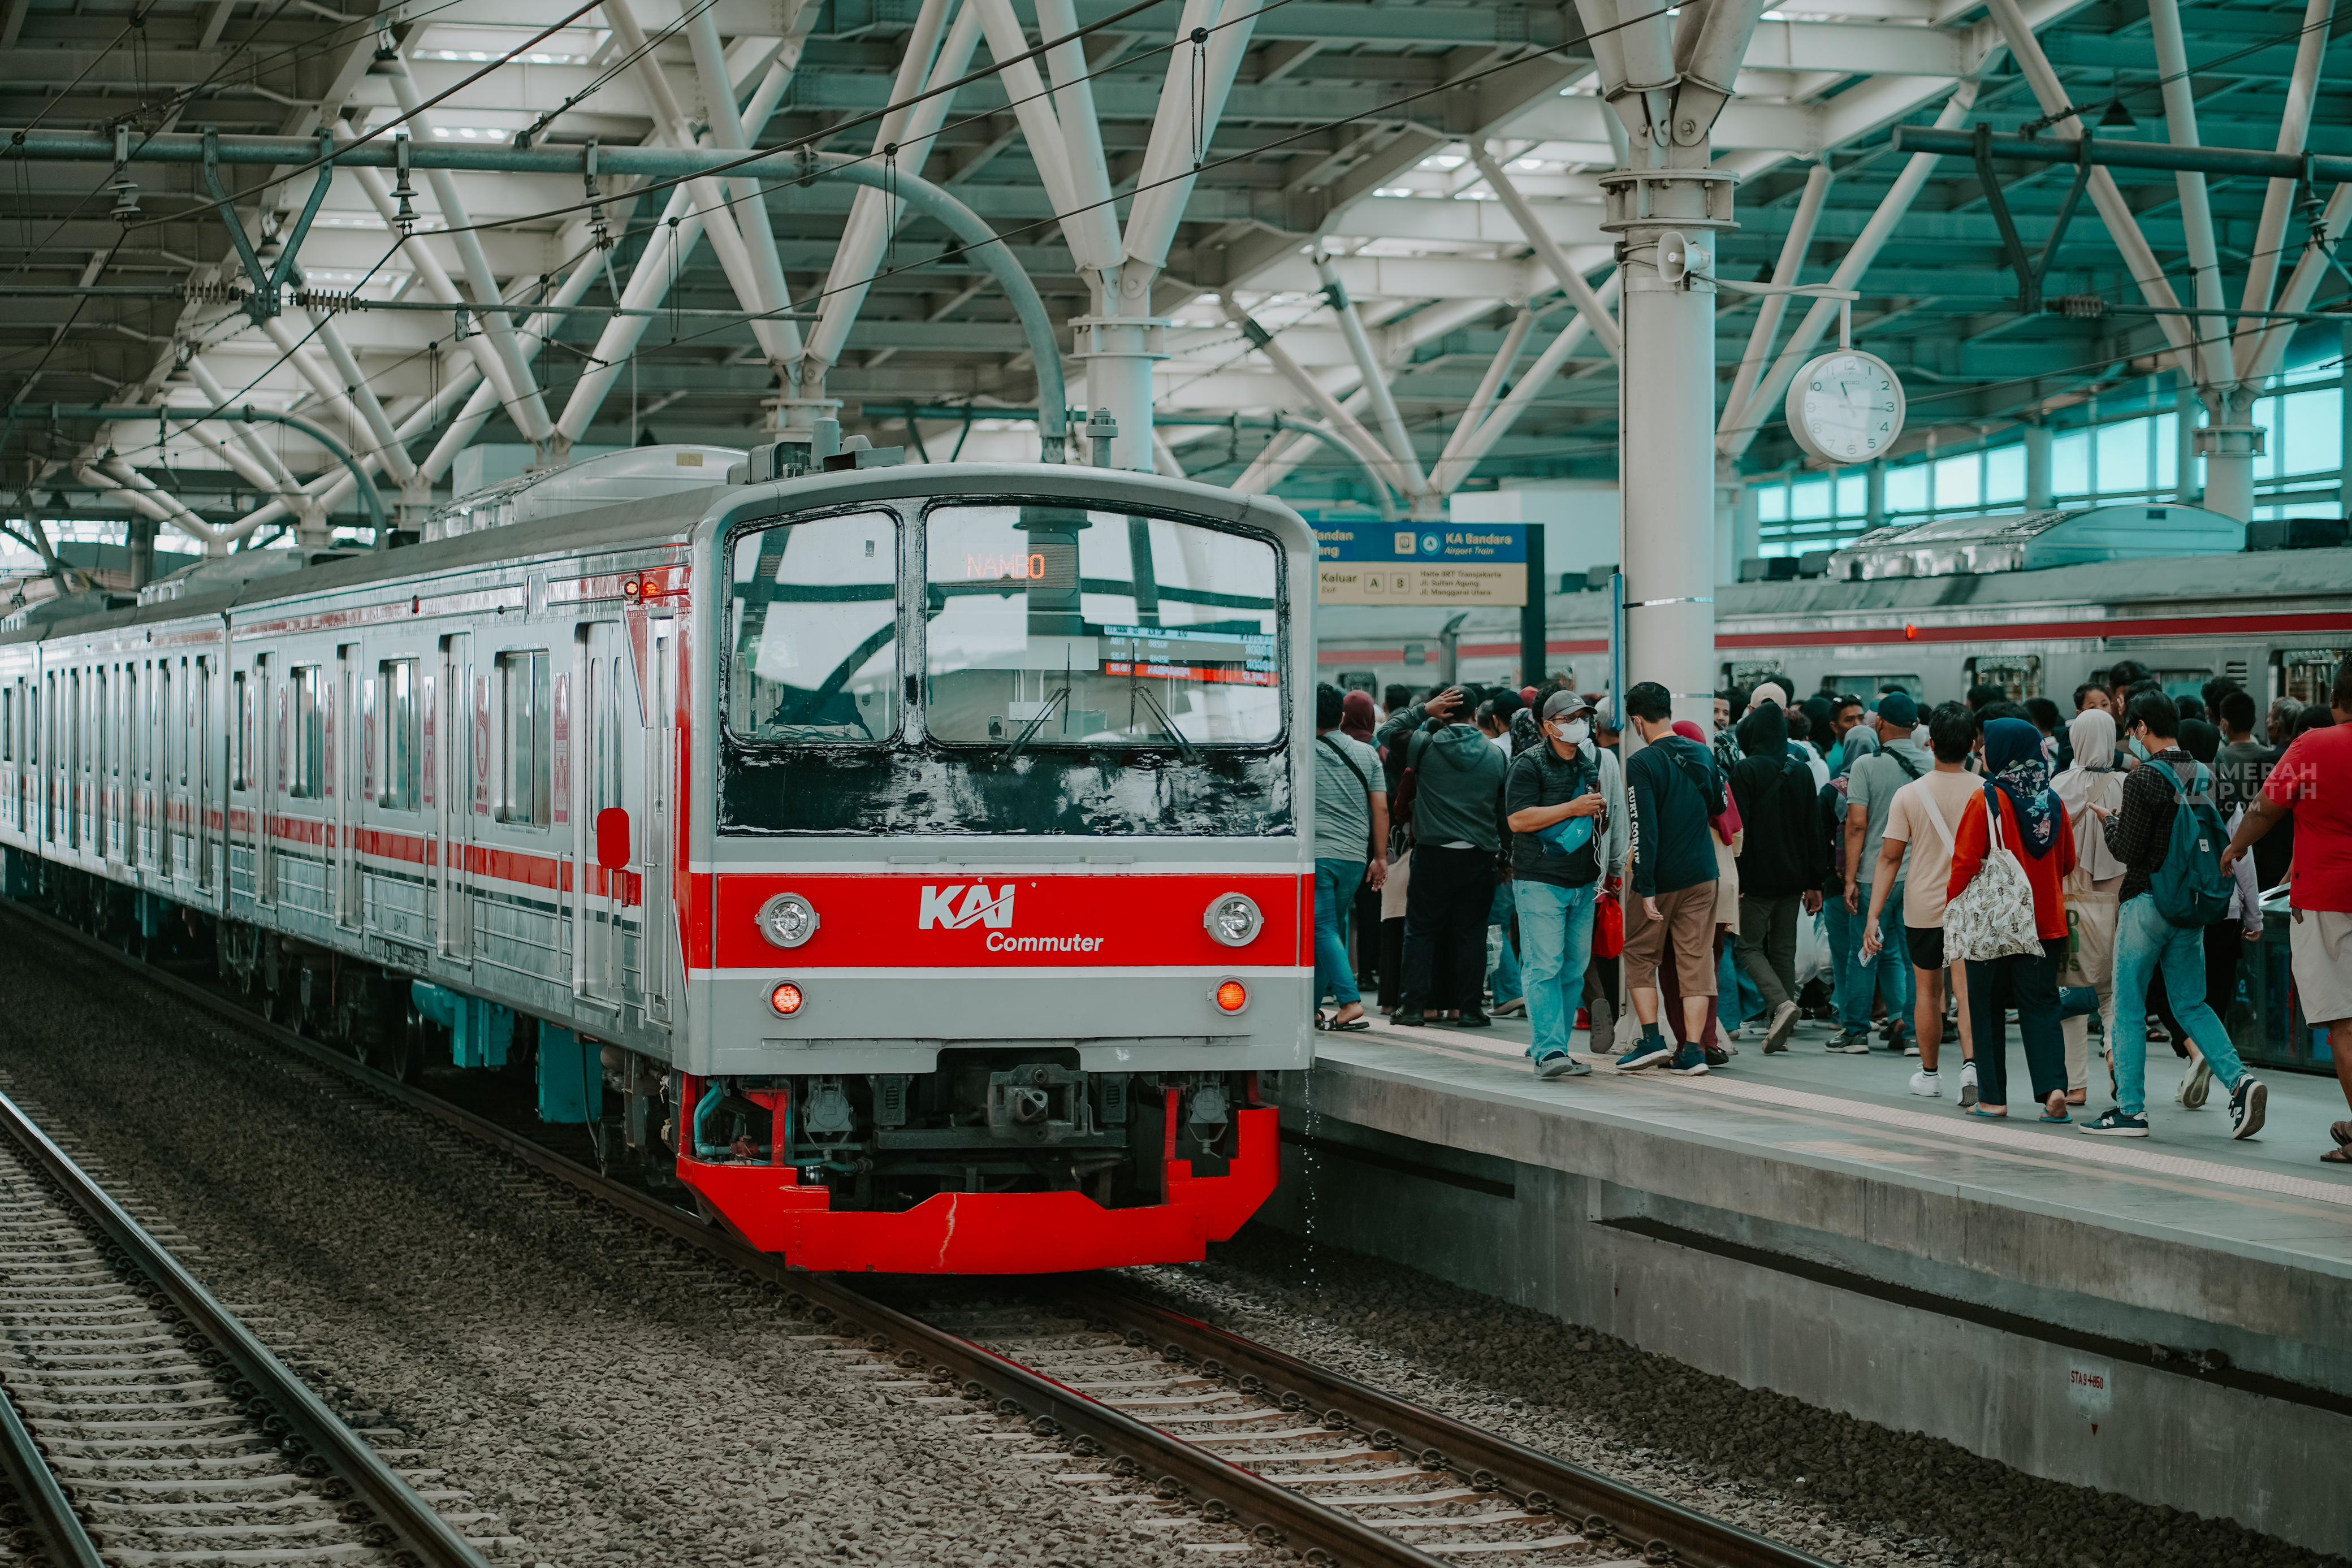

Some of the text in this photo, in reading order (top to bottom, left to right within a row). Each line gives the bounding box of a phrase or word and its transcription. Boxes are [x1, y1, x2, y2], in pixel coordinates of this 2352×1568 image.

[1844, 361, 1856, 370] 12
[1826, 366, 1834, 376] 11
[1810, 382, 1822, 391] 10
[1881, 380, 1890, 390] 2
[1806, 402, 1816, 413] 9
[1886, 402, 1894, 412] 3
[1812, 423, 1822, 434] 8
[1880, 422, 1889, 432] 4
[1826, 439, 1835, 449] 7
[1867, 439, 1876, 448] 5
[1847, 444, 1857, 454] 6
[1445, 533, 1512, 545] KA Bandara
[1319, 547, 1339, 558] ang
[1445, 547, 1472, 556] Airport
[966, 552, 1045, 579] NAMBO
[1321, 573, 1357, 583] Keluar
[1369, 578, 1378, 588] A
[1396, 579, 1403, 588] B
[1628, 785, 1638, 818] KURT
[918, 883, 1015, 930] KAI
[985, 932, 1104, 952] Commuter
